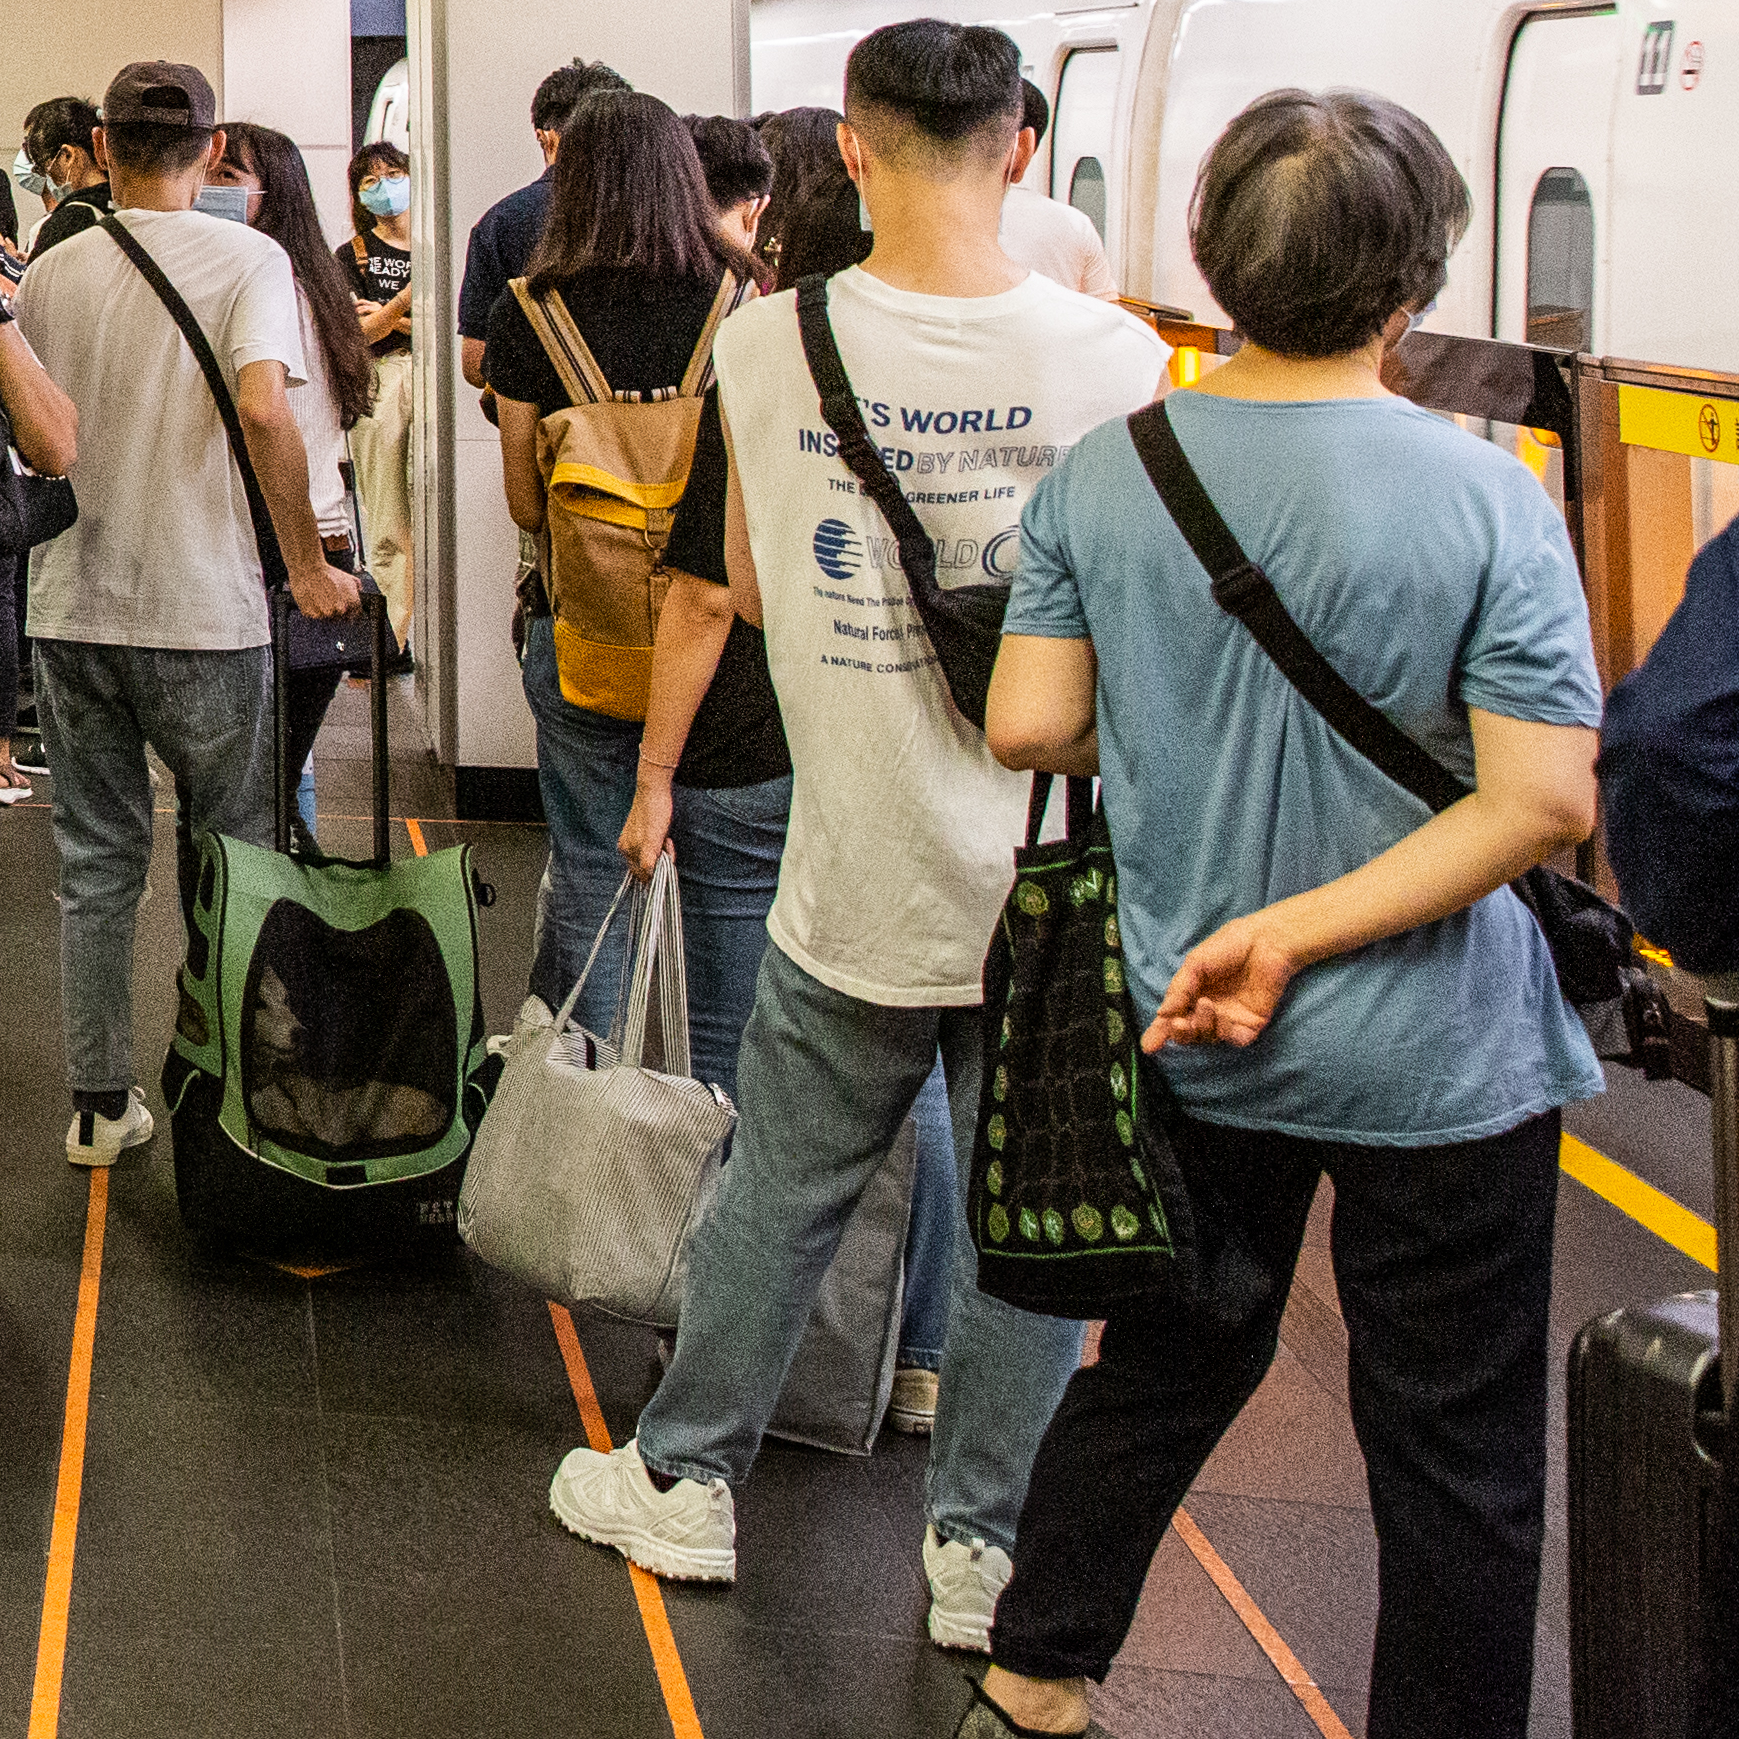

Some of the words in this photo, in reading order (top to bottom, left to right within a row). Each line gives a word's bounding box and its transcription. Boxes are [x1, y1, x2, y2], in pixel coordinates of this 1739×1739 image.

[379, 279, 400, 290] WE
[900, 406, 1032, 434] WORLD
[917, 452, 954, 474] BY
[827, 478, 855, 493] THE
[906, 491, 978, 504] GREENER
[984, 486, 1015, 500] LIFE
[833, 619, 869, 640] Natural
[820, 654, 828, 665] A
[830, 657, 872, 672] NATURE
